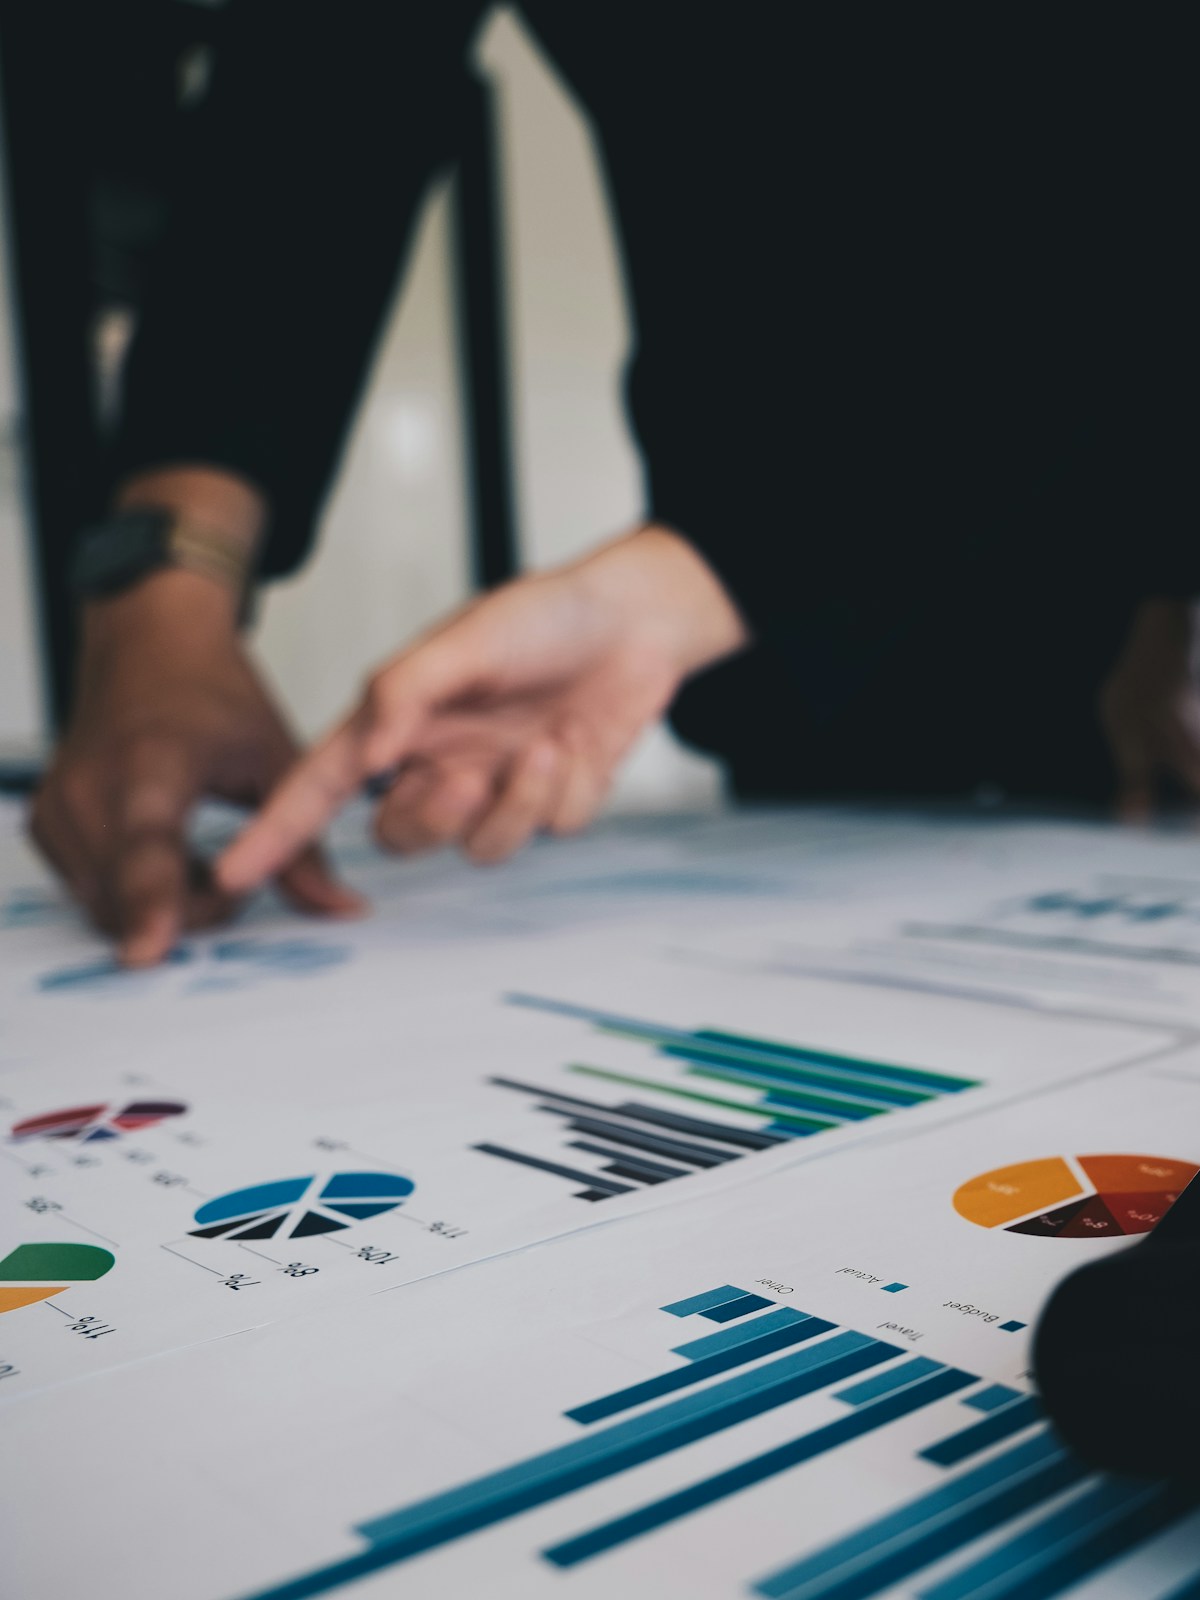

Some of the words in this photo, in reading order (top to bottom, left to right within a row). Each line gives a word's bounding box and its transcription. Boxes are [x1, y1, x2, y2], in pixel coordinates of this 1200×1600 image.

[351, 1246, 400, 1265] 10%
[276, 1261, 319, 1278] 8%
[835, 1267, 883, 1284] Actual
[218, 1273, 261, 1291] 7%
[755, 1277, 794, 1295] Other
[942, 1300, 1000, 1323] Budget
[64, 1317, 117, 1339] 11%
[876, 1321, 924, 1343] Travel
